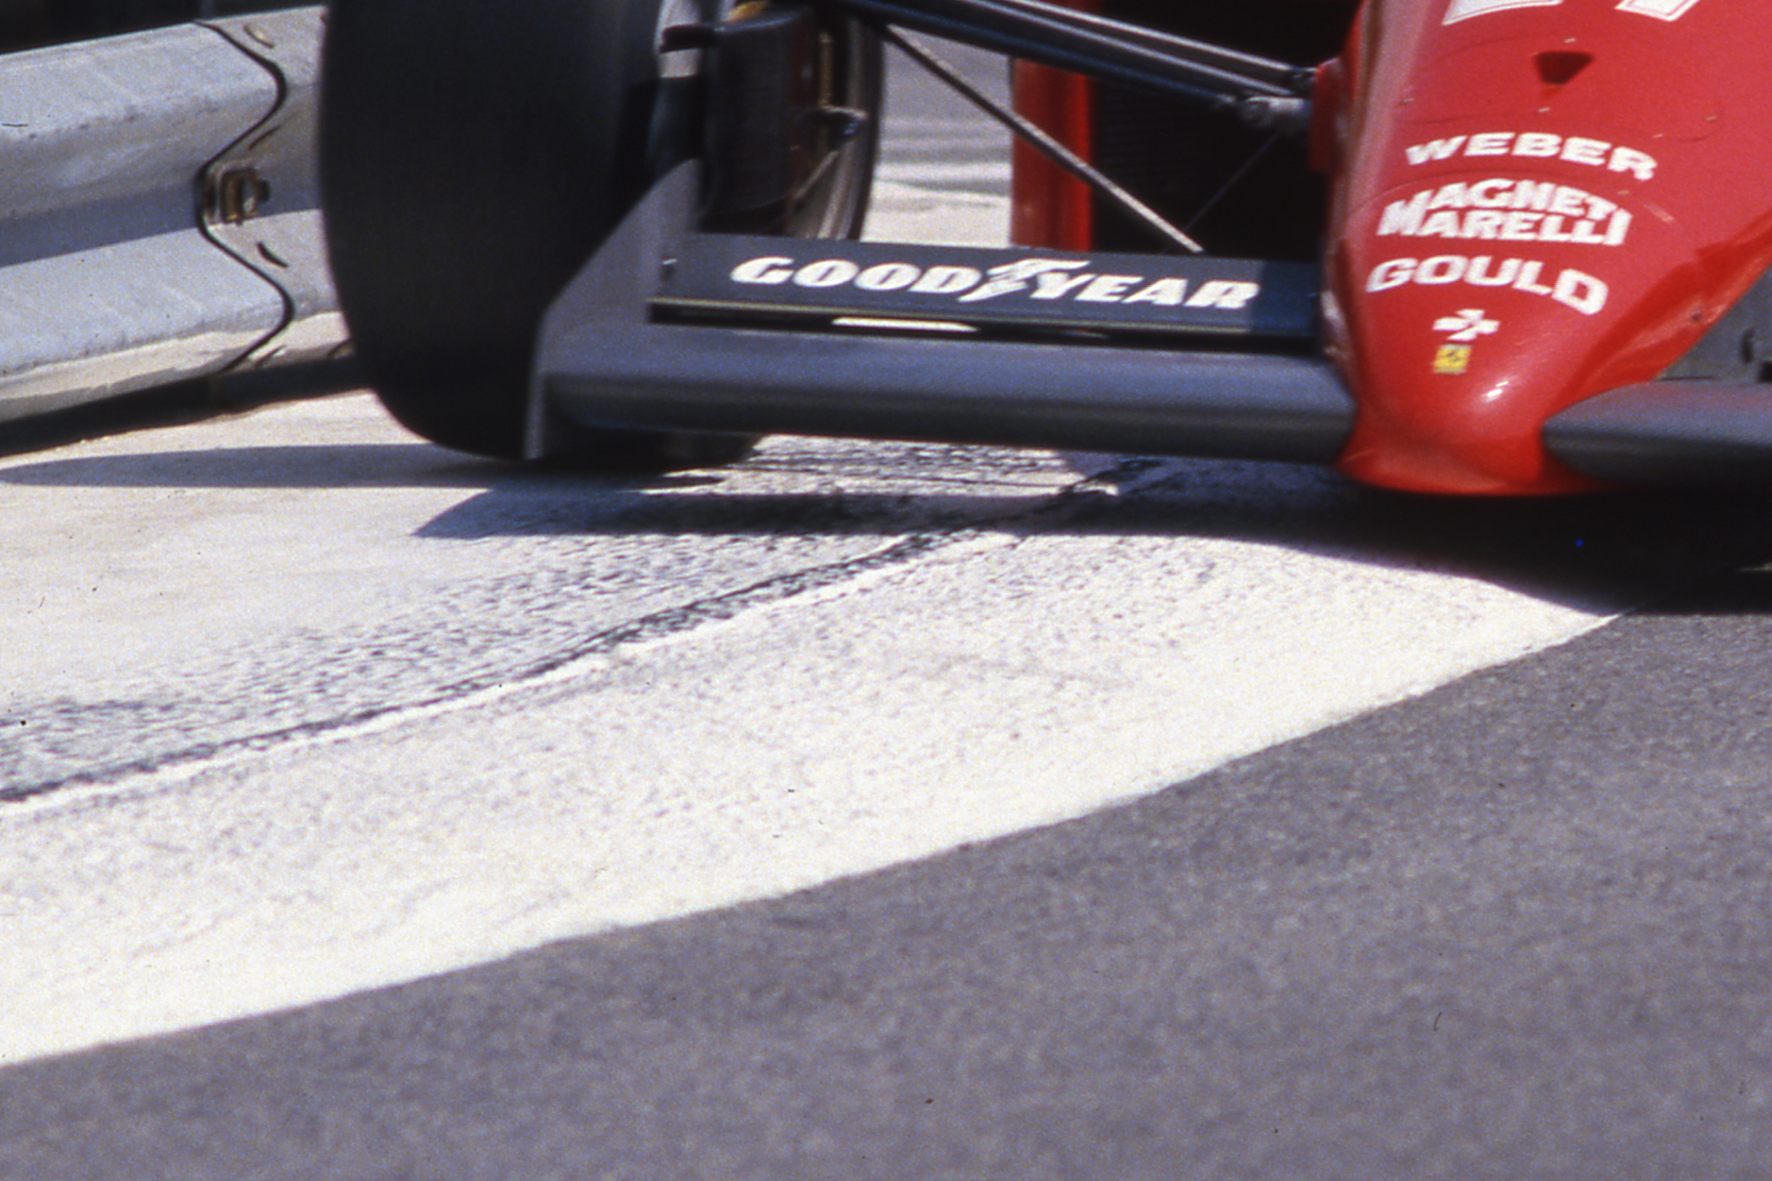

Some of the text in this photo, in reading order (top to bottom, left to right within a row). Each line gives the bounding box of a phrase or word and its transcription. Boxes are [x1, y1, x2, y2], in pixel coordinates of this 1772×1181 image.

[1405, 132, 1657, 181] WEBER
[1377, 203, 1632, 246] MARELLI
[1378, 178, 1631, 228] MAGNETI
[730, 256, 1261, 309] GOODYEAR
[1366, 255, 1609, 315] GOULD
